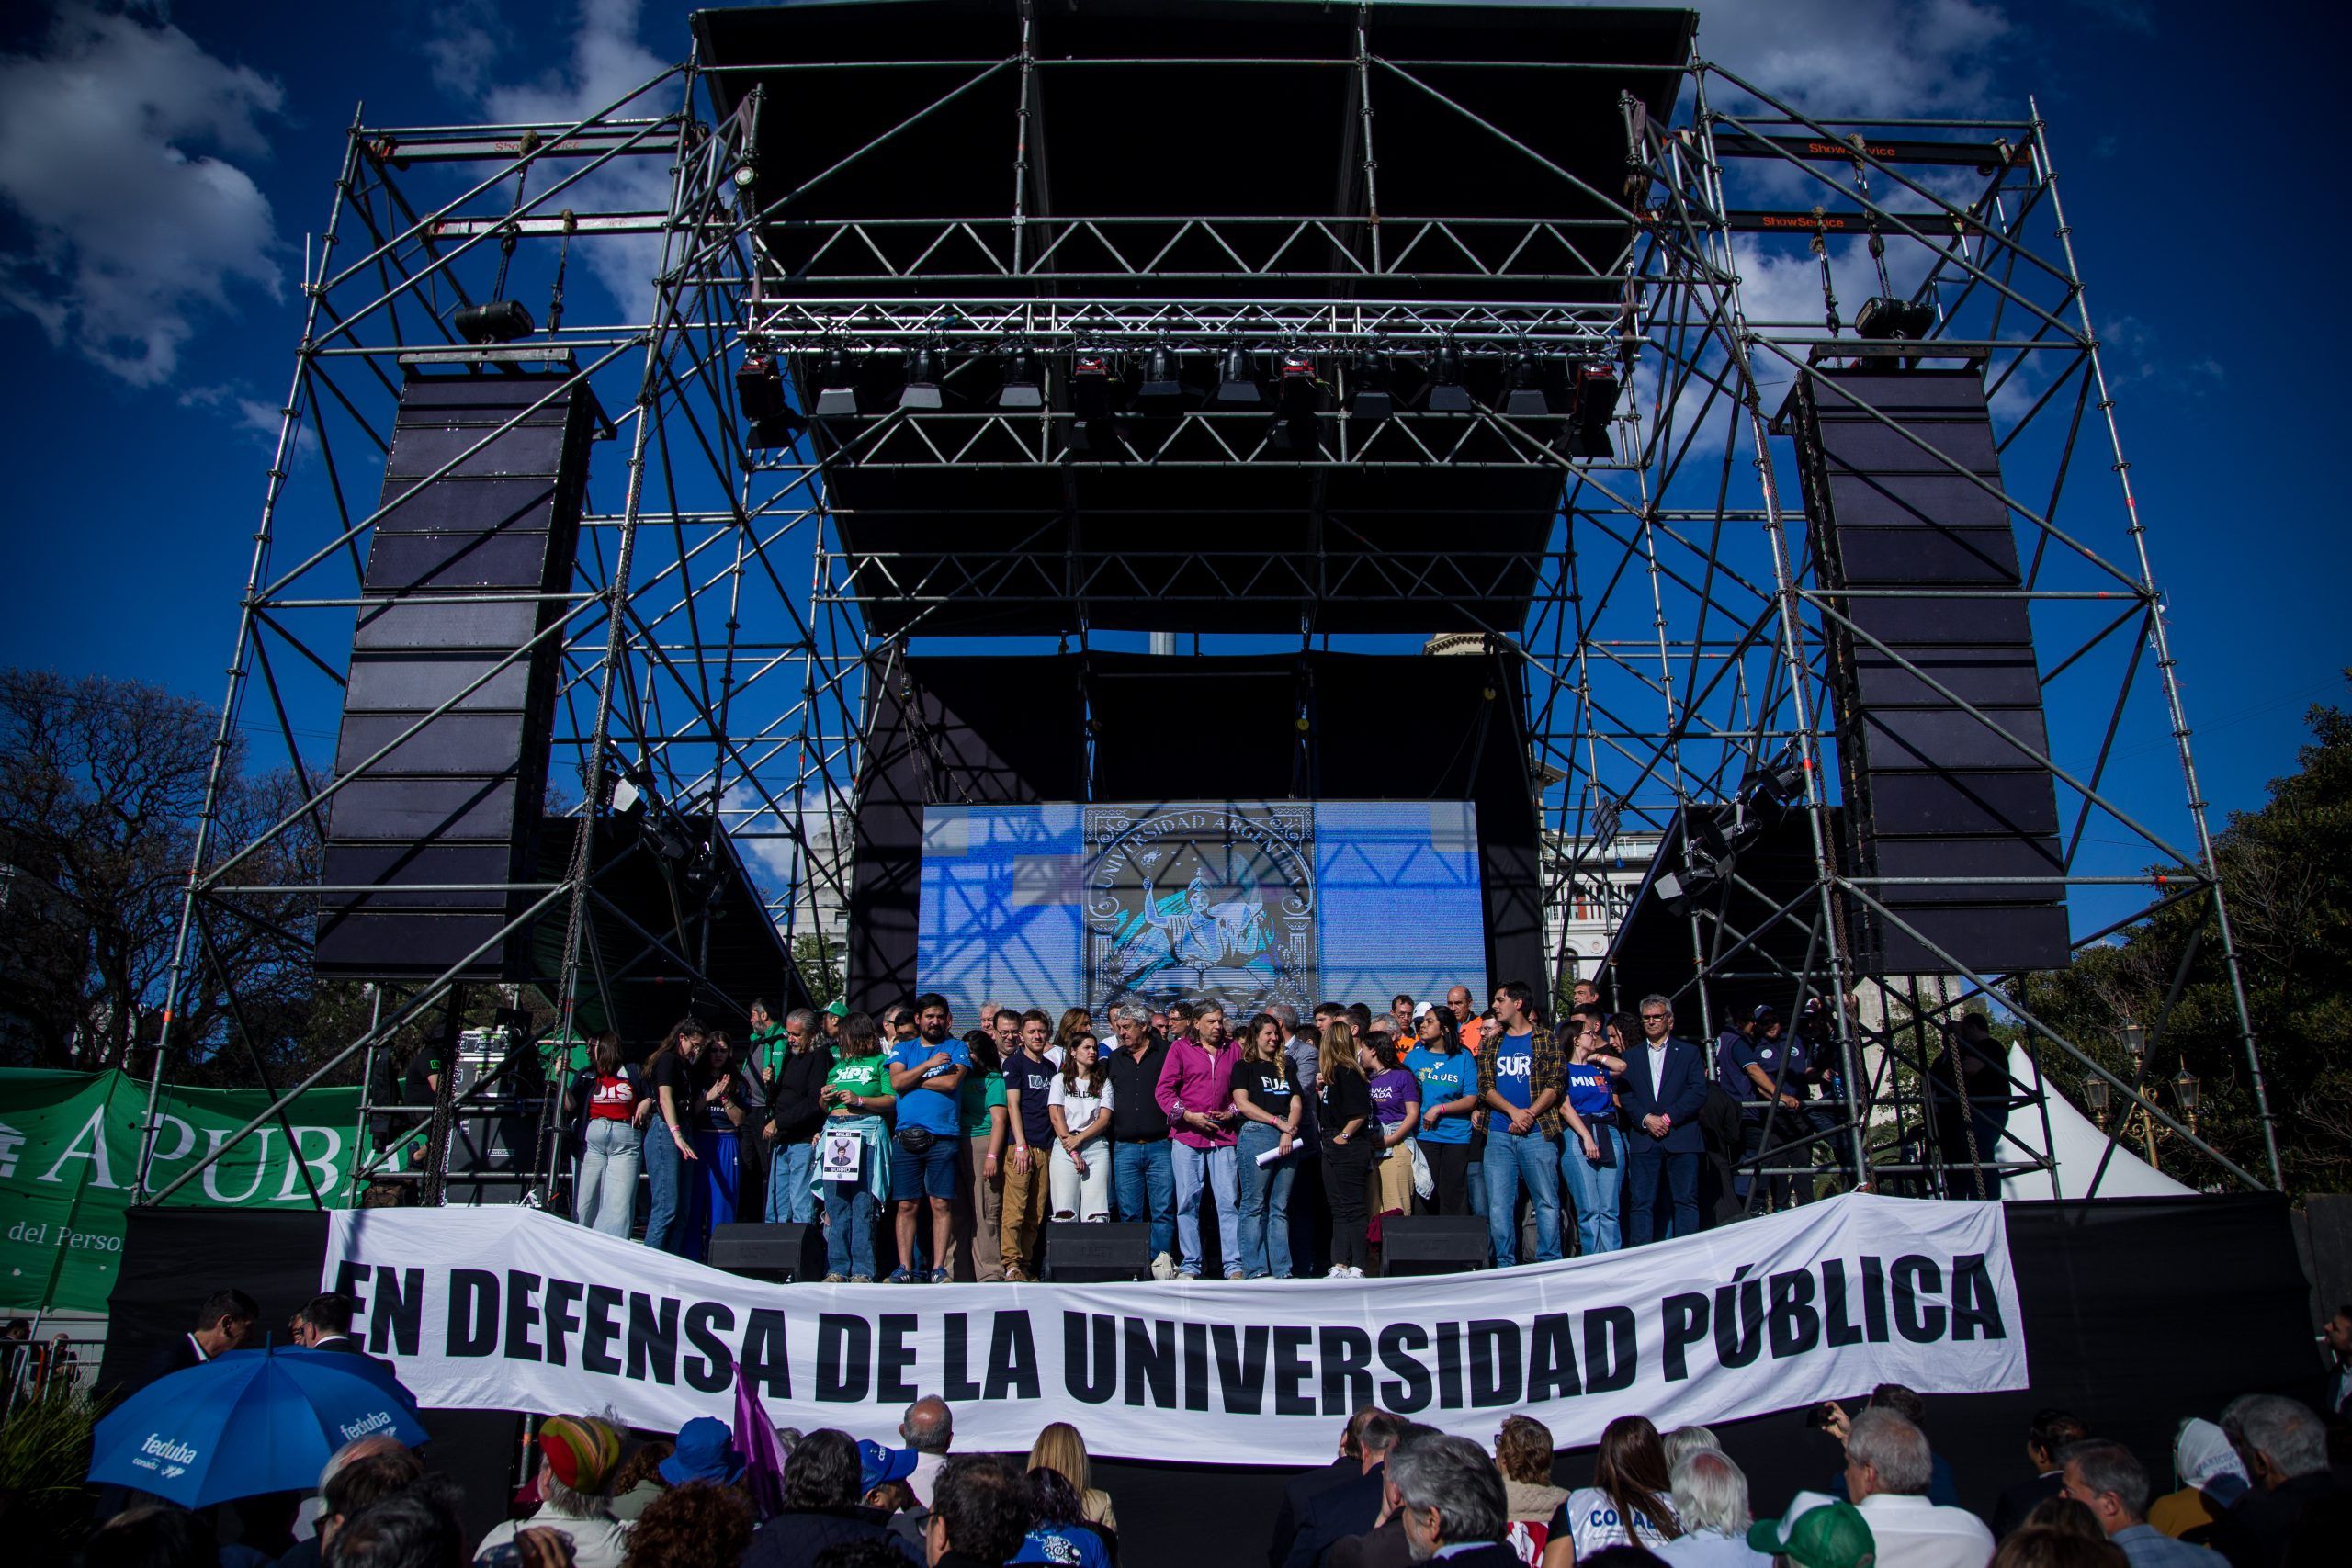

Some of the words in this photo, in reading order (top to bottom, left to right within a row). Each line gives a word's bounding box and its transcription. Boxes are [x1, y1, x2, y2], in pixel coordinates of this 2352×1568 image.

[1102, 815, 1206, 888] UNIVERSIDAD
[1212, 816, 1303, 886] ARGENTINA
[1441, 1073, 1459, 1082] UES
[1496, 1056, 1531, 1077] SUR
[1261, 1076, 1291, 1090] FUA
[1570, 1076, 1606, 1087] MNR
[8, 1221, 47, 1245] del
[54, 1227, 124, 1252] Perso
[334, 1260, 424, 1358] EN
[446, 1269, 792, 1400] DEFENSA
[815, 1313, 919, 1404] DE
[944, 1309, 1042, 1402] LA
[1063, 1305, 1639, 1416] UNIVERSIDAD
[1661, 1253, 2007, 1382] PÚBLICA
[340, 1411, 391, 1441] feduba
[141, 1433, 198, 1465] feduba
